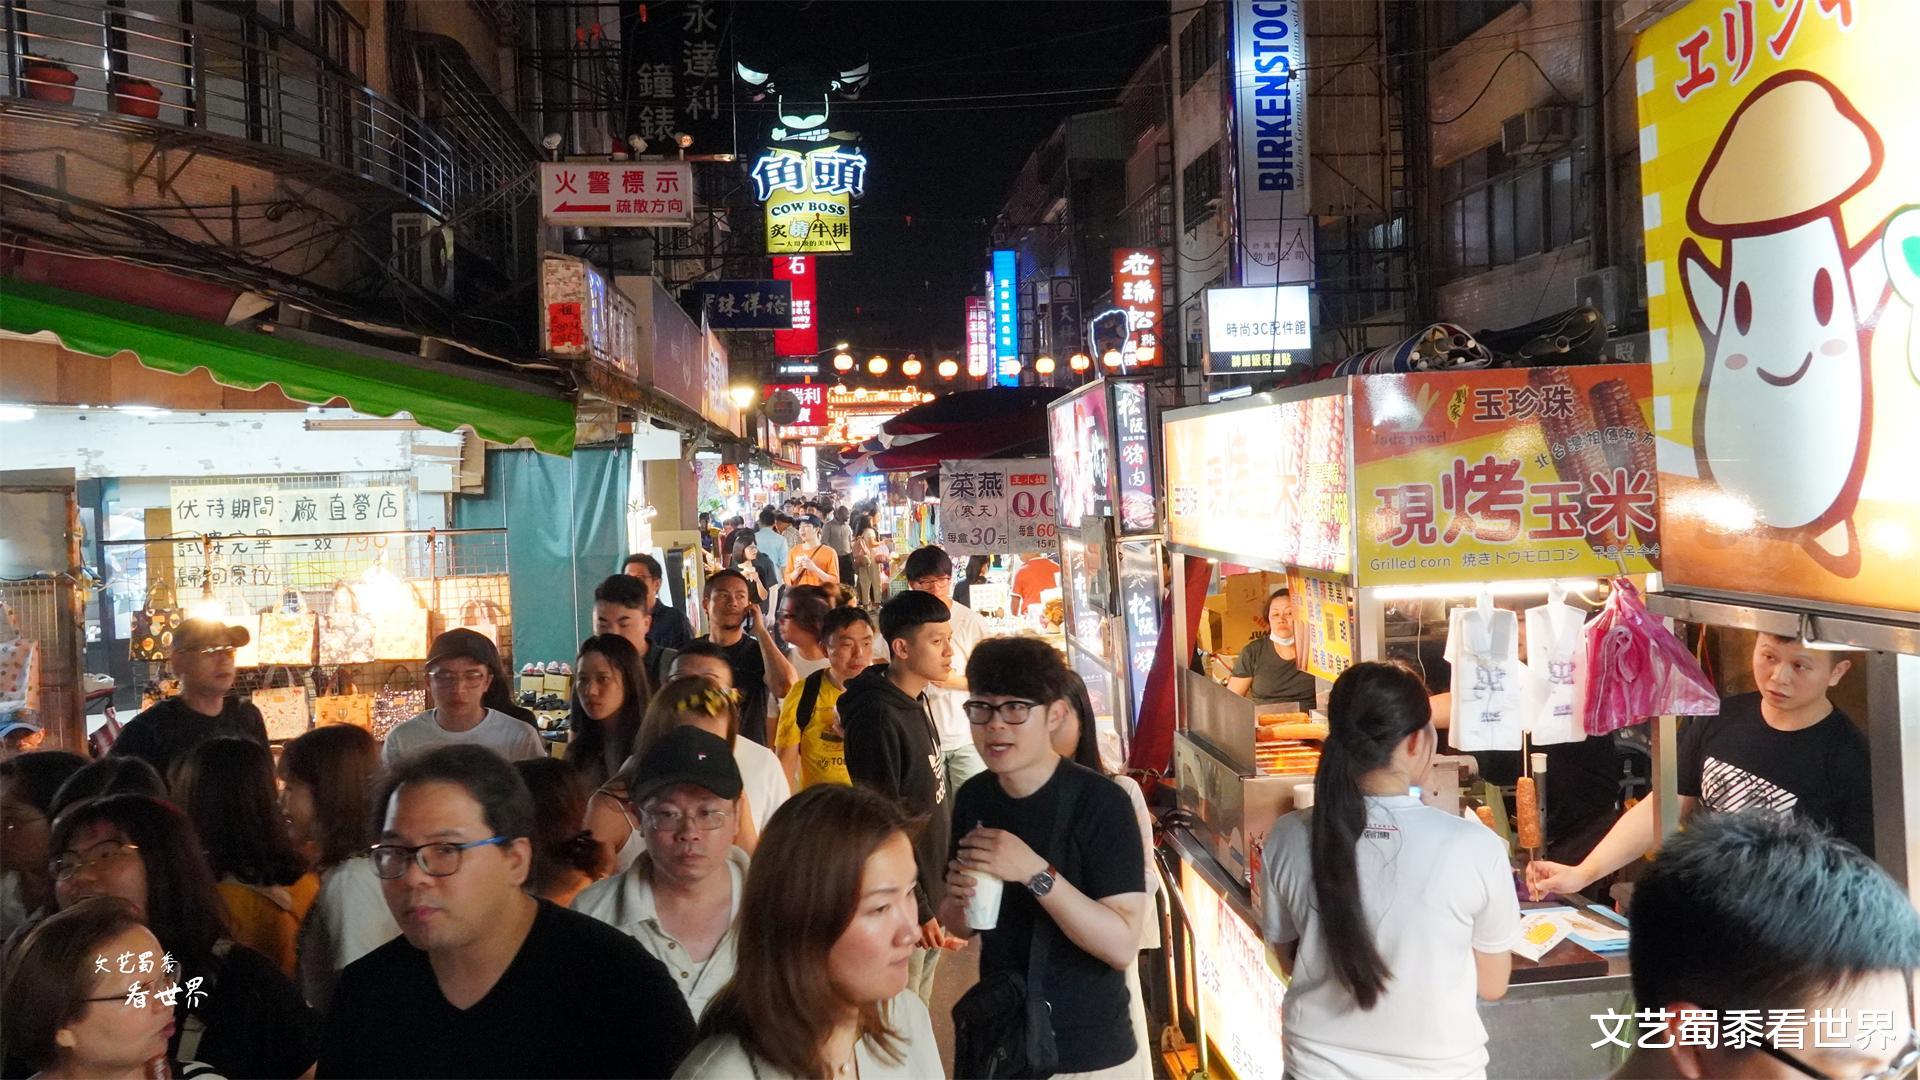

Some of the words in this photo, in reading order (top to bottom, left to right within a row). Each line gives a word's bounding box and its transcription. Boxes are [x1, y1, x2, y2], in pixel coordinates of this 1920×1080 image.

[1252, 0, 1294, 191] BIRKENSTOC
[555, 171, 679, 194] 火警標示
[752, 153, 867, 200] 角頭
[616, 199, 683, 214] 疏散方向
[771, 202, 804, 216] COW
[809, 202, 846, 215] BOSS
[1226, 320, 1306, 336] 時尚3C配件館
[1474, 385, 1574, 421] 玉珍珠
[950, 471, 1003, 498] 菜燕
[1374, 456, 1656, 546] 現烤玉米
[1370, 556, 1416, 570] Grilled
[1420, 557, 1451, 569] corn
[1462, 548, 1581, 567] 焼きトウモロコシ
